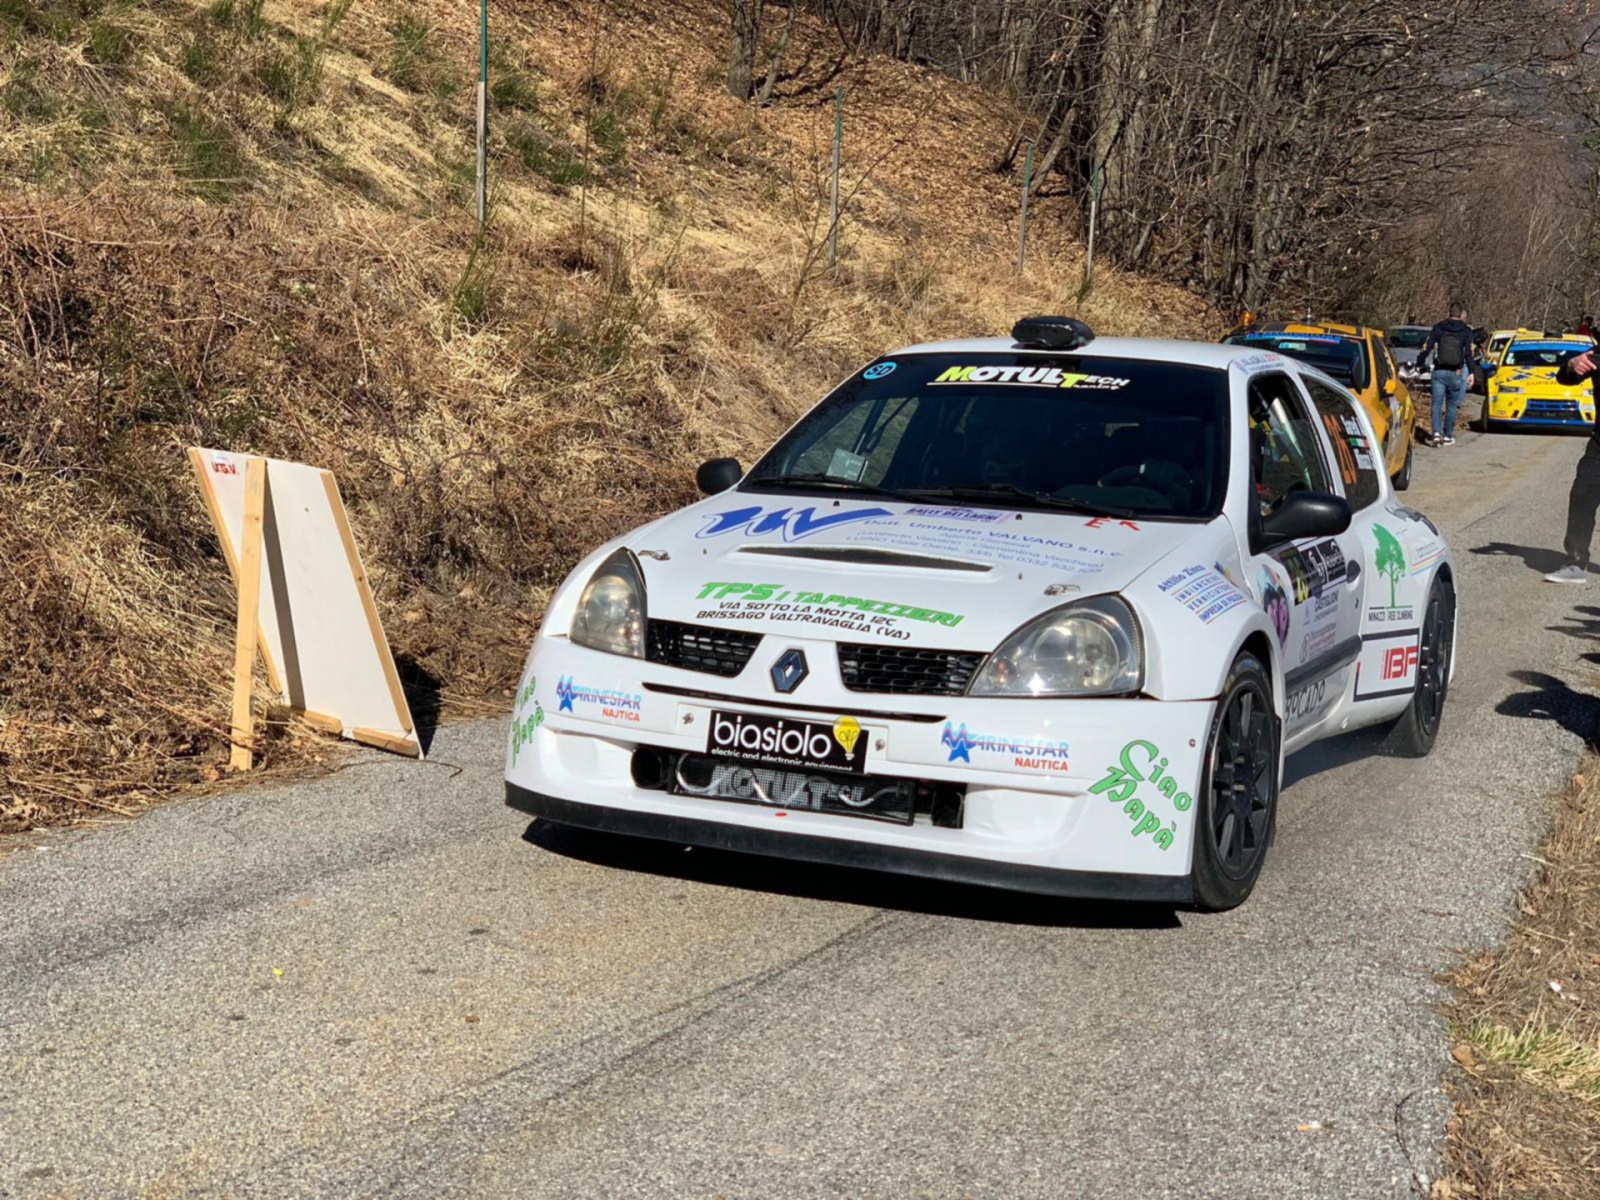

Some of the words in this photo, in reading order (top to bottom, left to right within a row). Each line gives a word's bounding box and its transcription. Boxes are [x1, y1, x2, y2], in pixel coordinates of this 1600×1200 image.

[909, 522, 982, 535] Umberto
[989, 531, 1073, 550] VALVANO
[695, 581, 785, 600] TPS
[793, 591, 965, 627] TAPPEZZIERI
[719, 601, 740, 609] VIA
[745, 602, 791, 611] SOTTO
[792, 604, 811, 613] LA
[815, 607, 865, 621] MOTTA
[696, 610, 765, 620] BRISSAGO
[769, 613, 871, 633] VALTRAVAGLIA
[876, 626, 911, 640] (VA)
[1383, 645, 1419, 680] IBF
[713, 713, 832, 759] biasiolo
[711, 748, 740, 758] electric
[742, 751, 760, 761] and
[761, 754, 803, 766] electronic
[1014, 757, 1069, 771] NAUTICA
[1119, 739, 1193, 812] Ciao
[1087, 766, 1177, 851] Papà
